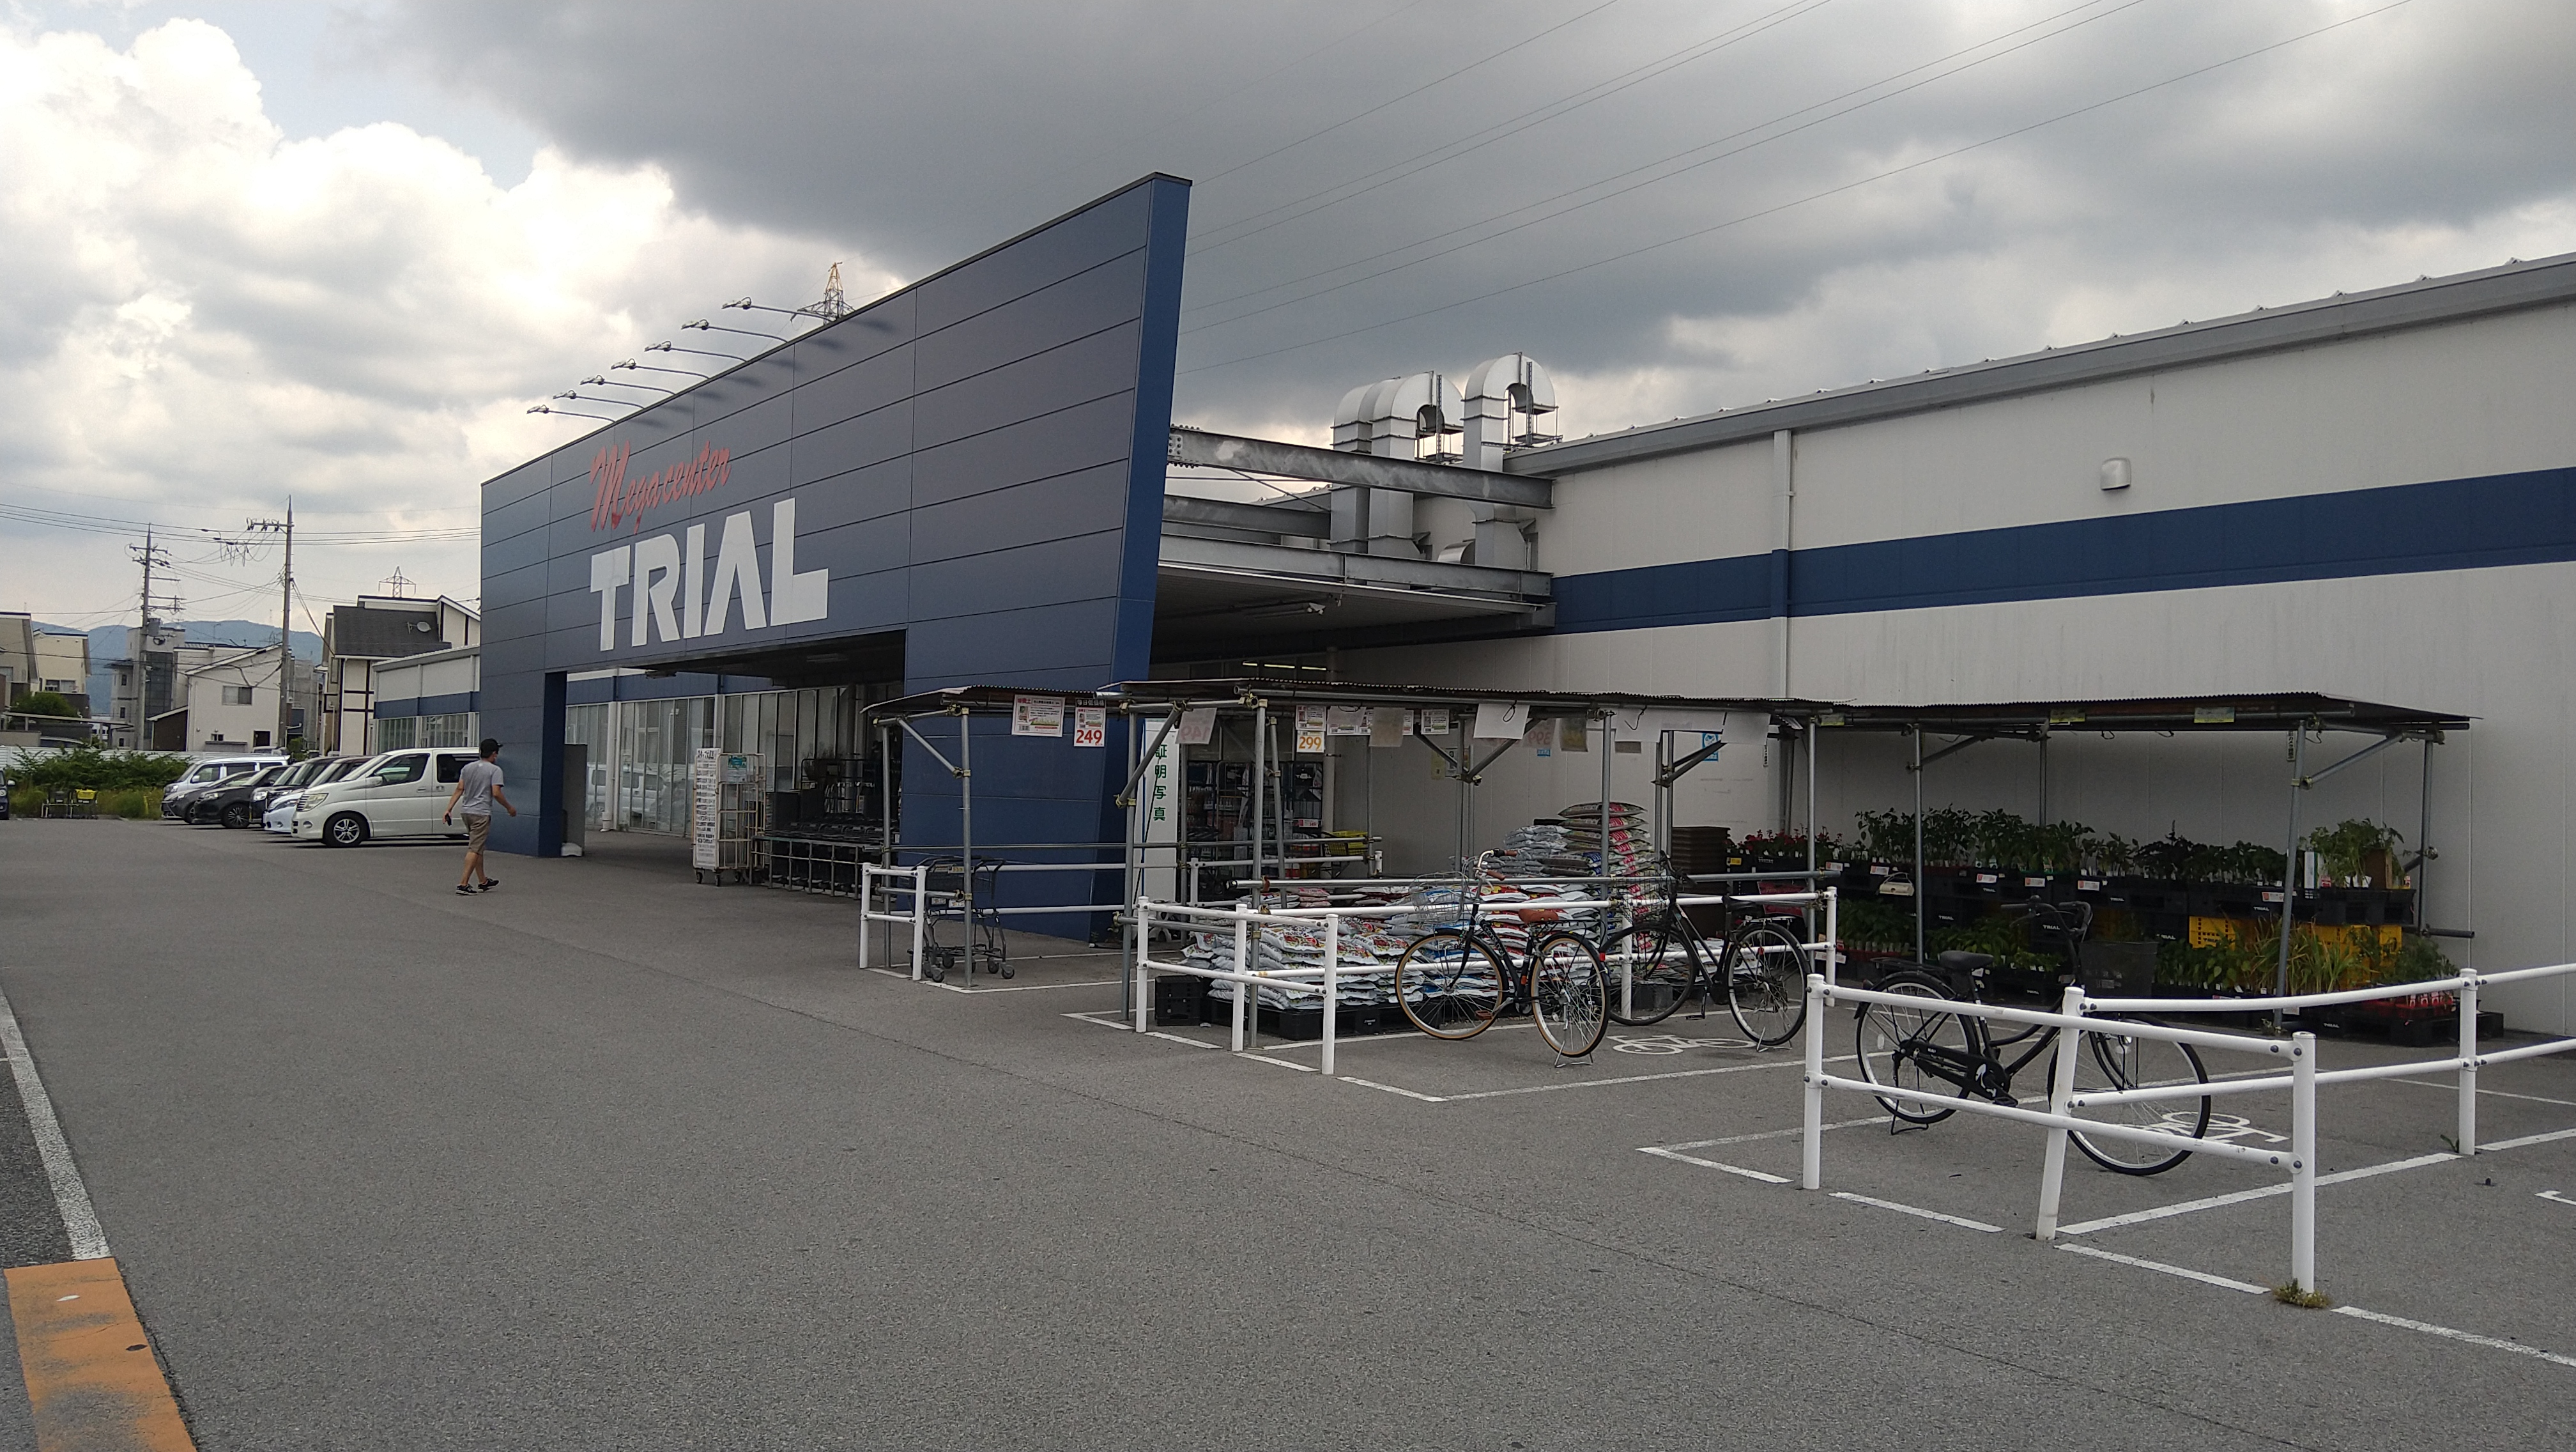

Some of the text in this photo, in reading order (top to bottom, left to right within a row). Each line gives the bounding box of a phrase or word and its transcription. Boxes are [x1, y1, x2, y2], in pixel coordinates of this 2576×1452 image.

[590, 497, 829, 652] TRIAL
[1076, 729, 1102, 744] 249
[1299, 736, 1322, 751] 299
[1153, 744, 1168, 821] 証明写真
